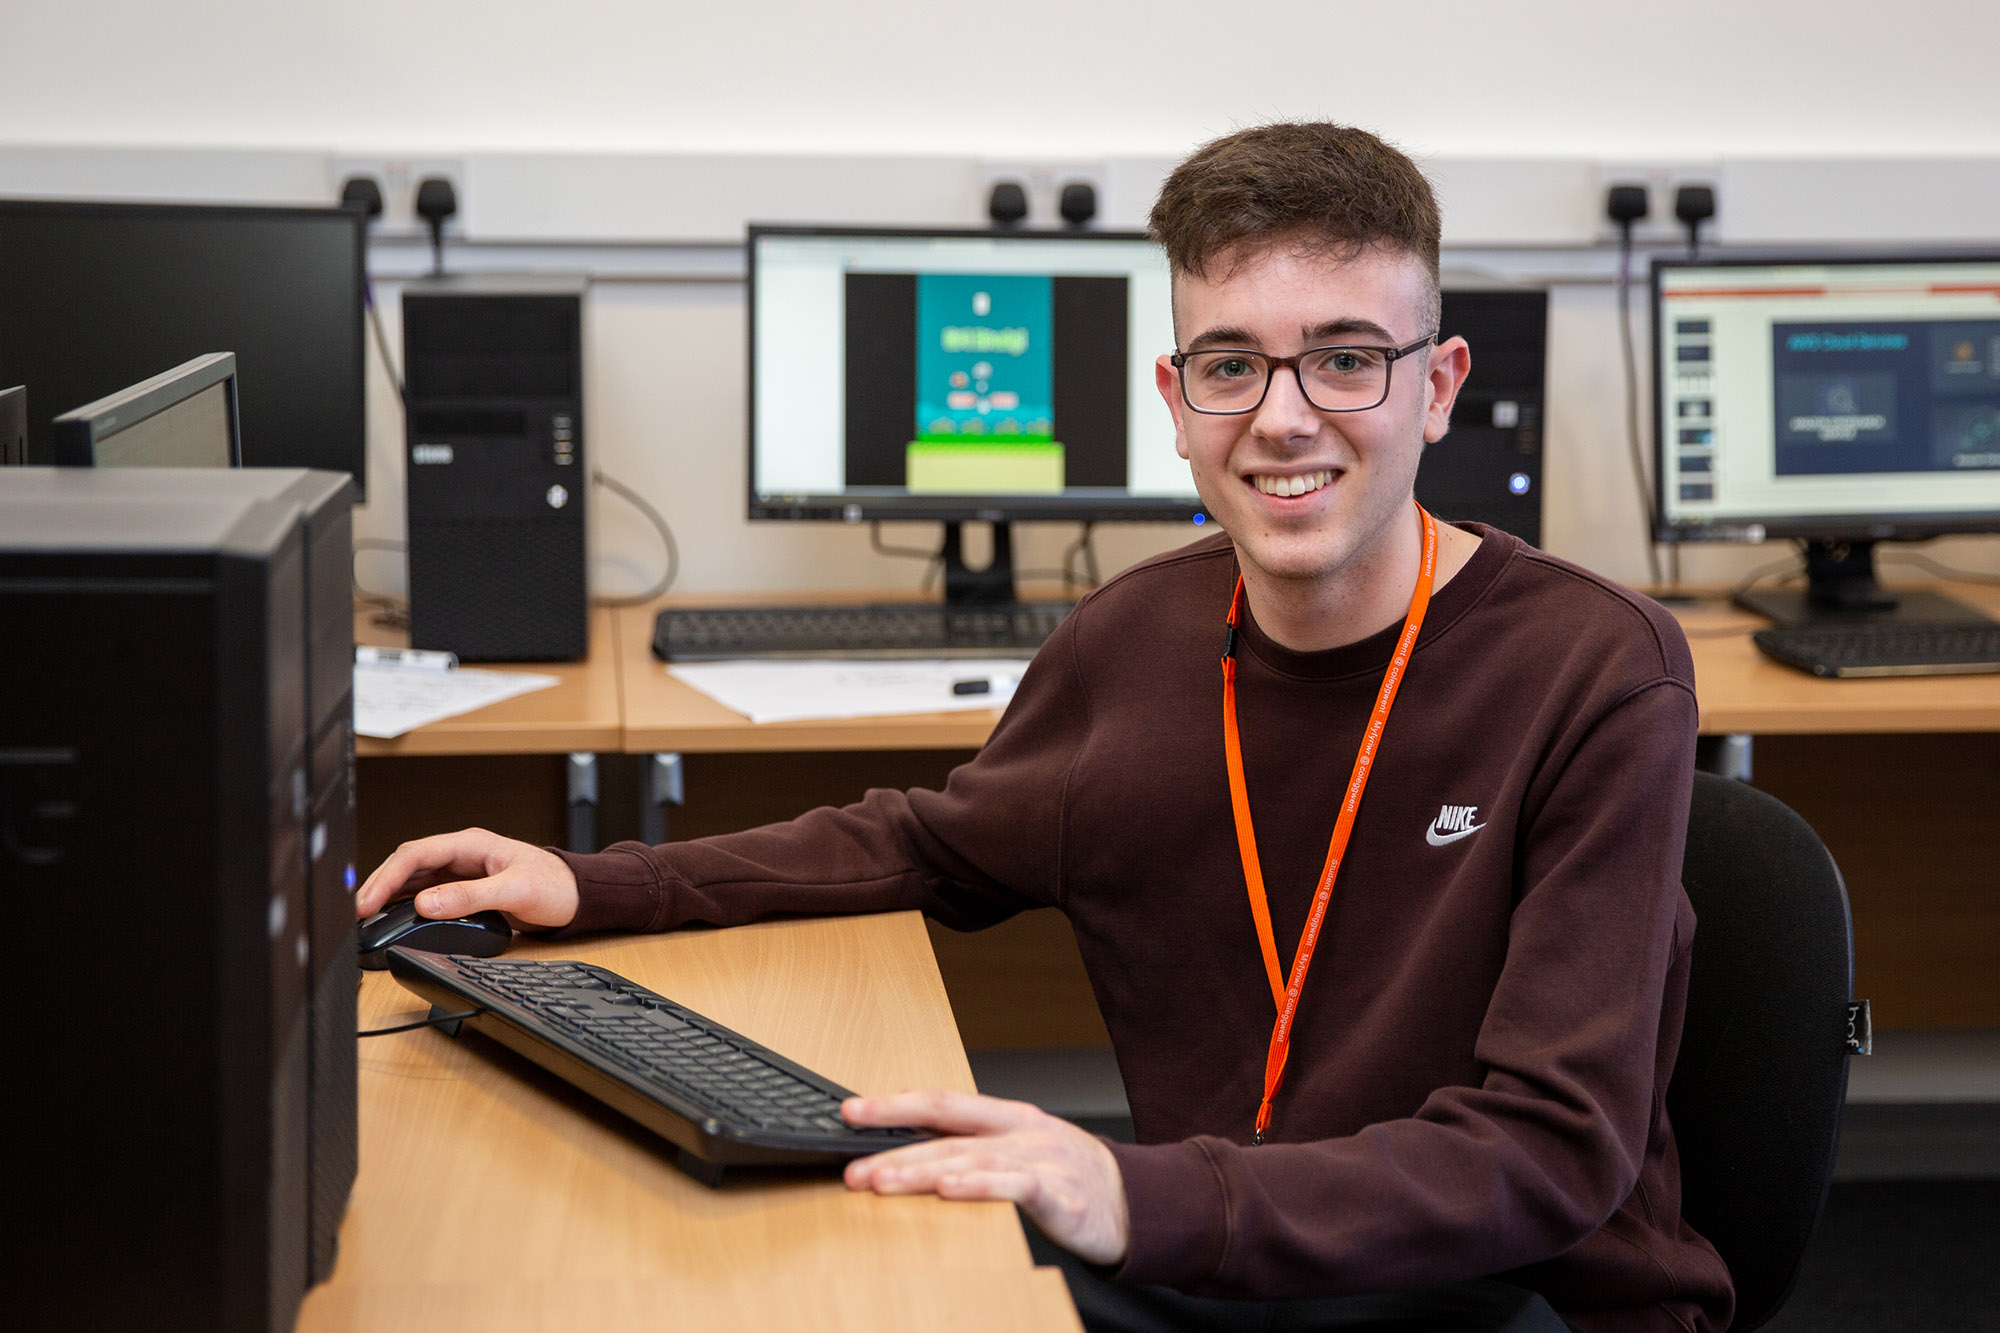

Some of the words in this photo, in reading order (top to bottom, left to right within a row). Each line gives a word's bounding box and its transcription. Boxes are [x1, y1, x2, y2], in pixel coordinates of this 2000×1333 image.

[1399, 624, 1418, 656] Student
[1394, 656, 1404, 667] @
[1379, 667, 1400, 713] coleggwent
[1360, 755, 1370, 766] @
[1346, 766, 1366, 812] coleggwent
[1436, 804, 1478, 831] NIKE
[1323, 858, 1339, 891] Student
[1319, 891, 1329, 901] @
[1306, 901, 1325, 947] coleggwent
[1288, 988, 1298, 998] @
[1277, 998, 1294, 1042] coleggwent
